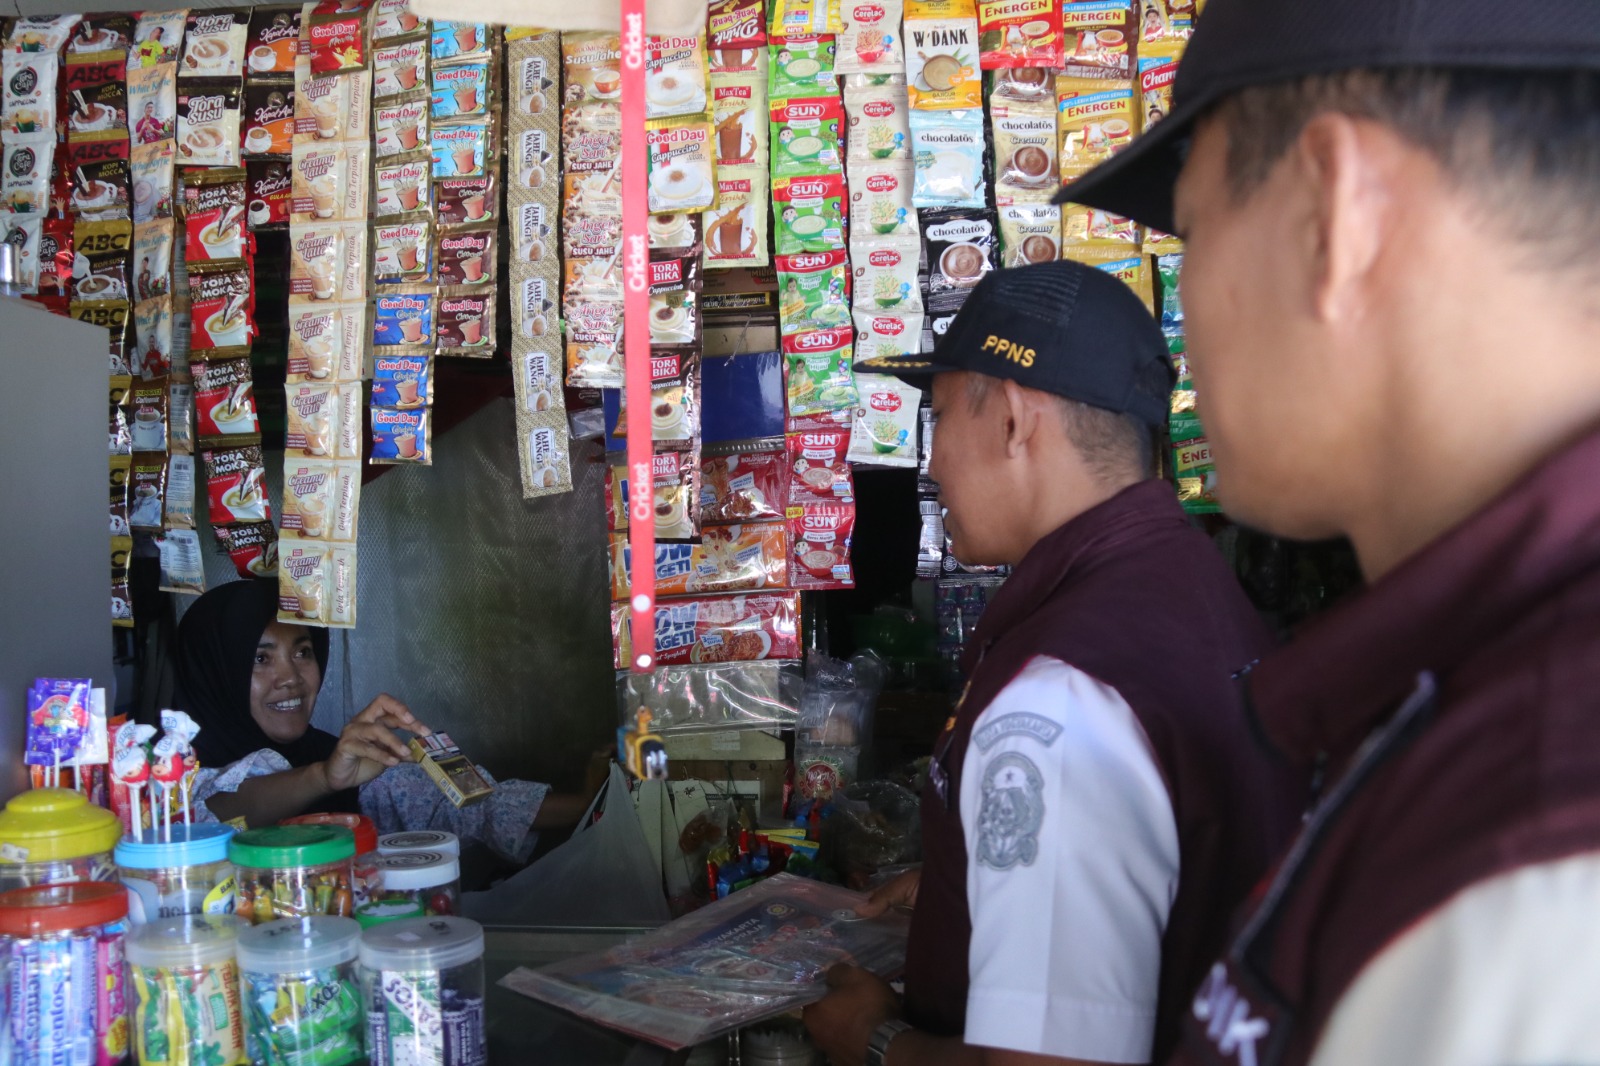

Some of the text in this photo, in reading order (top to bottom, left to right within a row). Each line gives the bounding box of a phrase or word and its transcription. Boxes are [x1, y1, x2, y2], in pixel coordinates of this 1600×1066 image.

[985, 1, 1048, 17] ENERGEN
[712, 8, 758, 28] beng-beng
[1064, 12, 1121, 22] ENERGEN
[715, 19, 759, 45] Drink
[626, 13, 642, 70] Cricket
[645, 37, 697, 51] ood Day
[378, 49, 419, 60] Good Day
[69, 64, 118, 83] ABC
[436, 70, 478, 81] Good Day
[533, 60, 541, 82] JAHE
[1142, 70, 1176, 88] Cham
[101, 84, 117, 92] KOPI
[352, 75, 360, 106] Terpisah
[719, 88, 747, 96] MaxTea
[97, 90, 122, 100] MOCCA
[1090, 94, 1110, 102] BANYAK
[1111, 91, 1130, 99] SEREAL
[189, 96, 225, 112] Tora
[1068, 100, 1126, 117] ENERGEN
[379, 107, 420, 120] Good Day
[789, 106, 819, 116] SUN
[433, 131, 477, 140] Good Day
[646, 130, 705, 145] Good Day
[524, 132, 532, 165] WANGI
[532, 133, 541, 155] JAHE
[71, 142, 122, 161] ABC
[651, 144, 700, 163] Cappuccino
[299, 154, 335, 171] Creamy
[571, 161, 613, 170] SUSU JAHE
[99, 168, 123, 177] MOCCA
[304, 163, 328, 181] Latte
[380, 168, 422, 180] Good Day
[719, 181, 747, 191] MaxTea
[792, 184, 823, 195] SUN
[200, 189, 227, 200] TORA
[198, 197, 229, 210] MOKA
[530, 206, 539, 228] JAHE
[380, 228, 420, 239] Good Day
[79, 234, 127, 251] ABC
[296, 236, 334, 251] Creamy
[442, 238, 484, 249] Good Day
[347, 235, 357, 274] Terpisah
[573, 246, 614, 255] SUSU JAHE
[630, 234, 645, 291] Cricket
[795, 255, 827, 268] SUN
[870, 254, 899, 264] Cerelac
[652, 262, 679, 273] TORA
[654, 270, 679, 281] BIKA
[202, 277, 231, 288] TORA
[202, 285, 234, 298] MOKA
[532, 280, 541, 303] JAHE
[380, 299, 424, 310] Good Day
[442, 300, 483, 311] Good Day
[79, 307, 124, 326] ABC
[293, 315, 331, 330] Creamy
[344, 315, 354, 351] Terpisah
[873, 321, 903, 332] Cerelac
[299, 325, 323, 342] Latte
[802, 334, 833, 348] SUN
[982, 335, 1036, 368] PPNS
[378, 361, 422, 371] Good Day
[536, 356, 544, 378] JAHE
[651, 358, 677, 368] TORA
[205, 366, 234, 378] TORA
[529, 356, 537, 388] WANGI
[653, 368, 676, 376] BIKA
[207, 375, 237, 388] MOKA
[291, 392, 327, 407] Creamy
[871, 397, 900, 407] Cerelac
[297, 403, 321, 418] Latte
[343, 392, 351, 428] Terpisah
[377, 414, 418, 424] Good Day
[540, 431, 550, 453] JAHE
[801, 434, 837, 446] SUN
[533, 430, 543, 464] WANGI
[214, 452, 243, 464] TORA
[652, 457, 676, 466] TORA
[215, 461, 250, 475] MOKA
[653, 464, 676, 474] BIKA
[288, 473, 325, 486] Creamy
[294, 484, 317, 498] Latte
[634, 463, 650, 520] Cricket
[338, 475, 349, 531] Gula Terpisah
[805, 517, 837, 528] SUN
[232, 528, 260, 538] TORA
[235, 536, 266, 547] MOKA
[283, 555, 321, 569] Creamy
[290, 566, 313, 580] Latte
[220, 962, 242, 1049] TOLAK ANGIN
